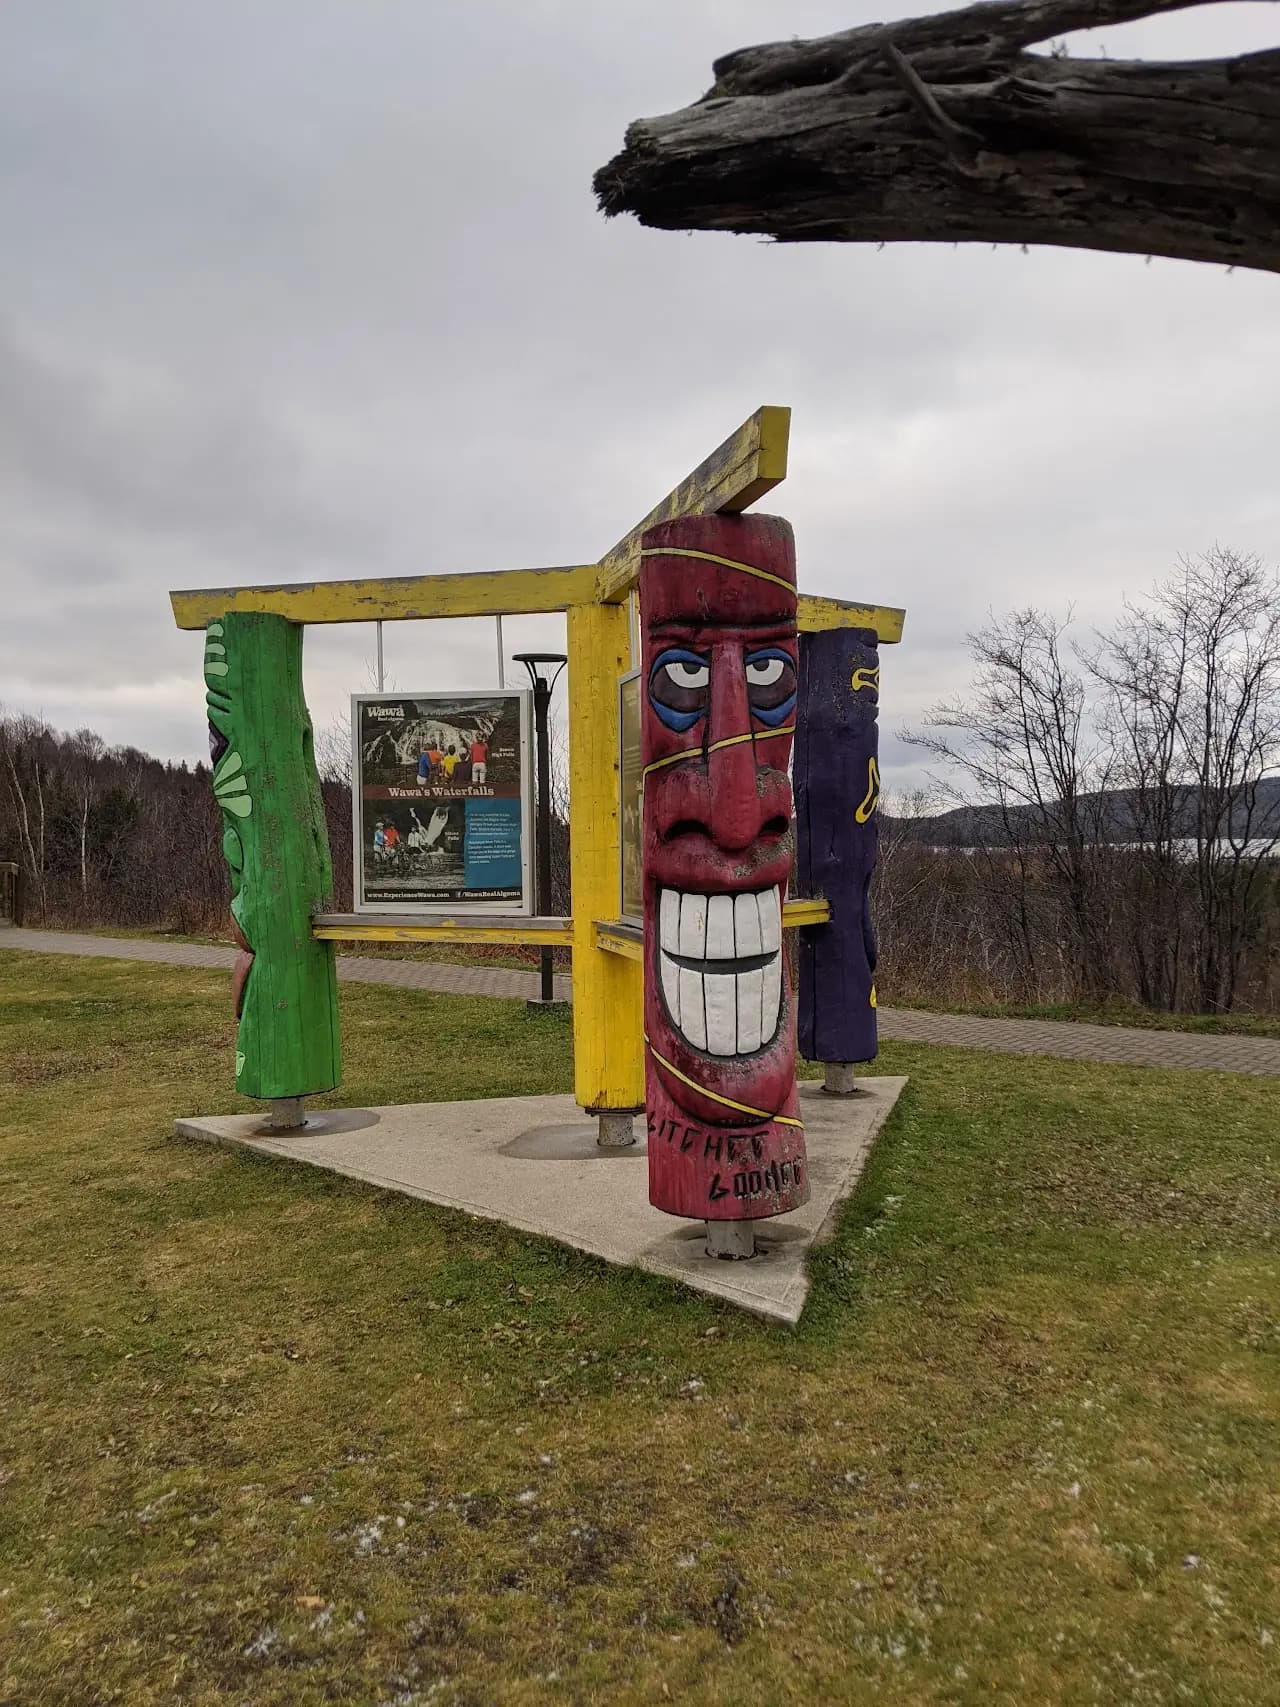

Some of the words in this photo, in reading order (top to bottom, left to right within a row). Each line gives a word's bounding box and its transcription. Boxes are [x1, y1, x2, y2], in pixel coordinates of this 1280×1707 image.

[366, 704, 405, 717] Wawa
[388, 787, 430, 797] Wawa's
[432, 786, 495, 796] Waterfalls
